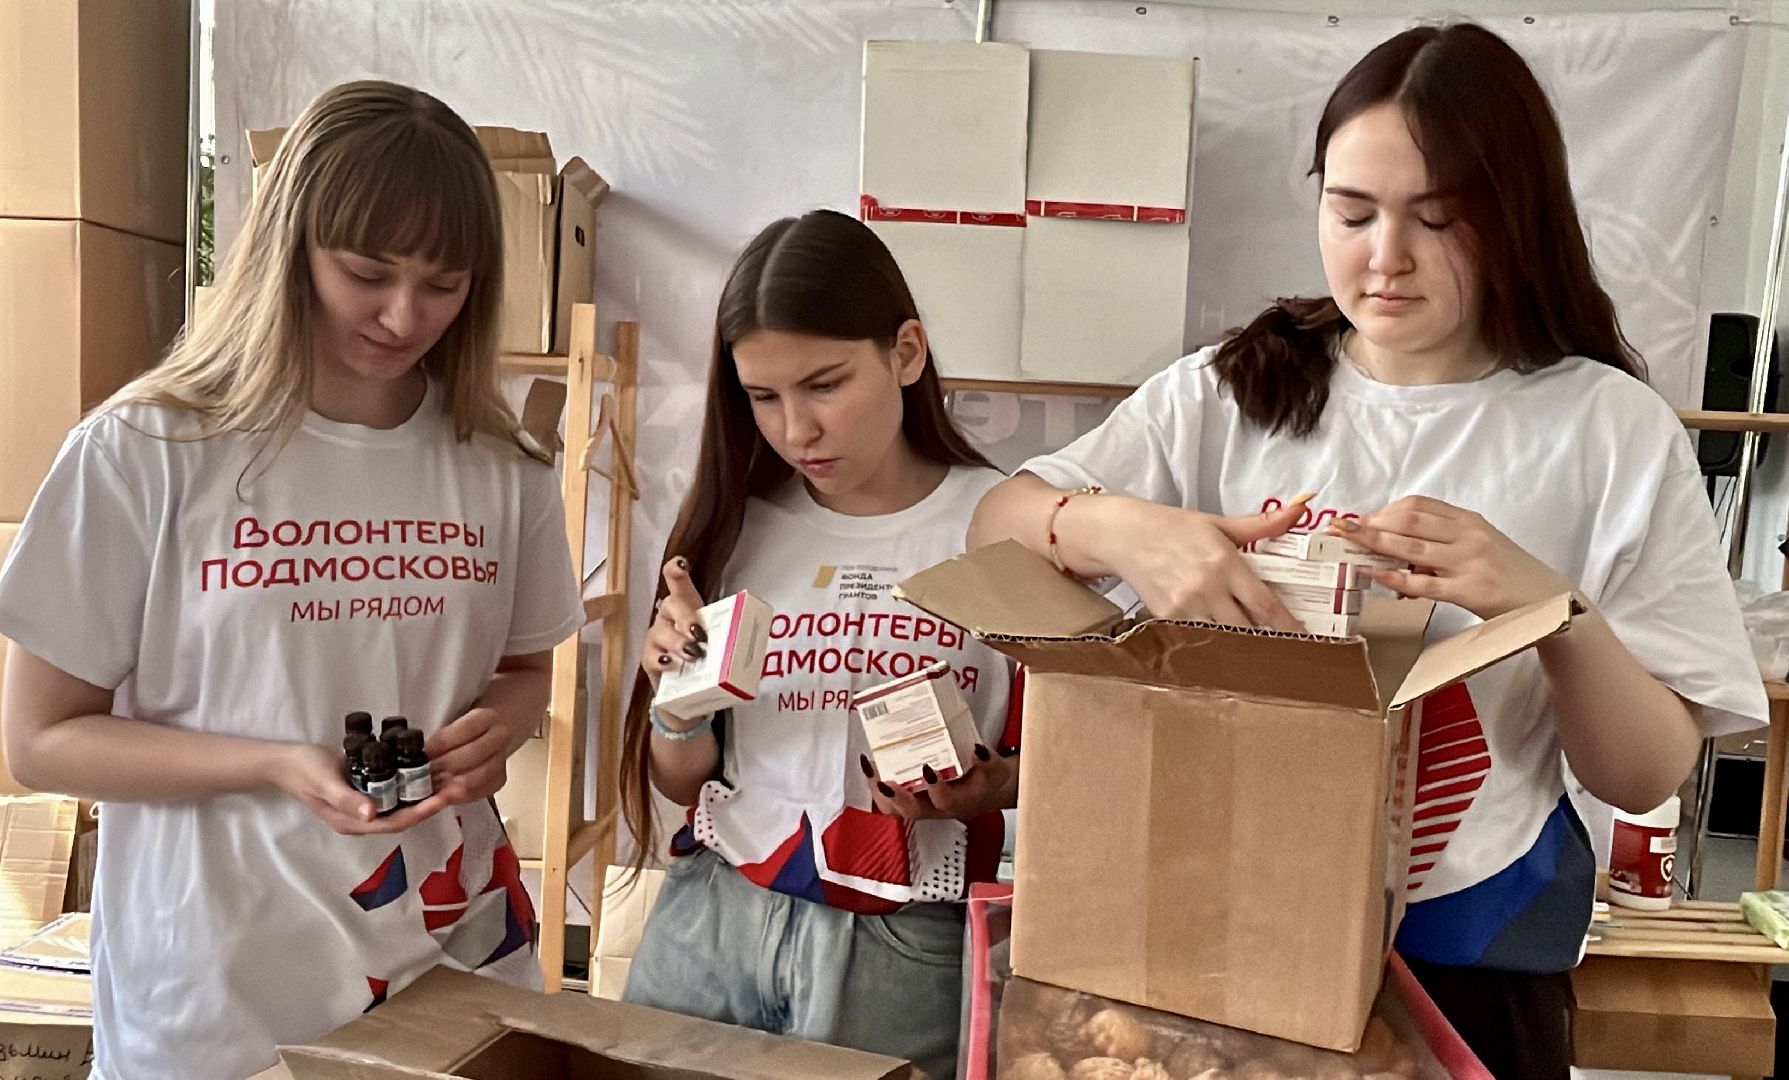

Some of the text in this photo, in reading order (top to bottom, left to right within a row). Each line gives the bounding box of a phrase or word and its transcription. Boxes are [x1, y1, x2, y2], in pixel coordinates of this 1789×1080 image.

[233, 517, 484, 549] ВОЛОНТЕРЫ
[201, 555, 499, 591] ПОДМОСКОВЬЯ
[290, 596, 445, 622] МЫ РЯДОМ
[768, 612, 964, 650] ОЛОНТЕРЫ
[777, 690, 814, 712] МЫ
